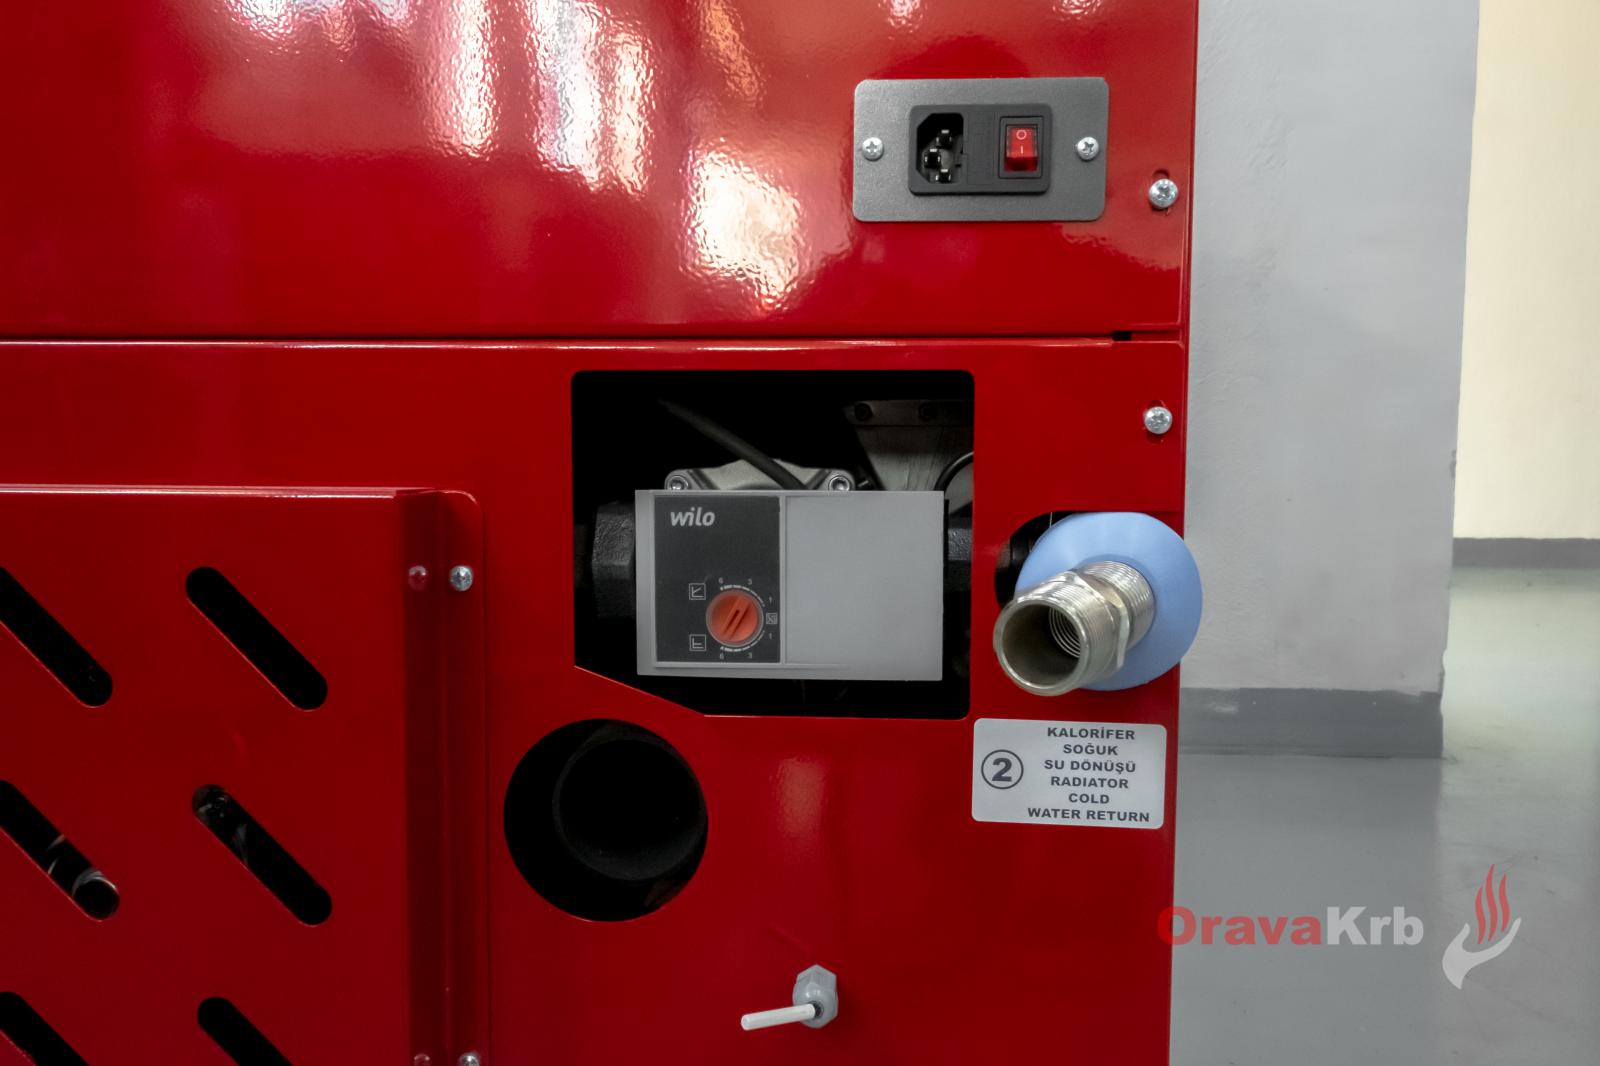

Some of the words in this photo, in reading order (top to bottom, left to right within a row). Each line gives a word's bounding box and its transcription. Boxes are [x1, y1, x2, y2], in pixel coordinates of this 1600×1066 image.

[670, 507, 716, 527] wilo
[1047, 726, 1136, 740] KALORİFER
[1063, 742, 1118, 756] SOĞUK
[991, 757, 1012, 782] 2
[1044, 759, 1065, 770] SU
[1070, 760, 1136, 775] DÖNÜŞÜ
[1050, 776, 1129, 789] RADIATOR
[1068, 793, 1110, 804] COLD
[1027, 807, 1081, 820] WATER
[1086, 810, 1150, 822] RETURN
